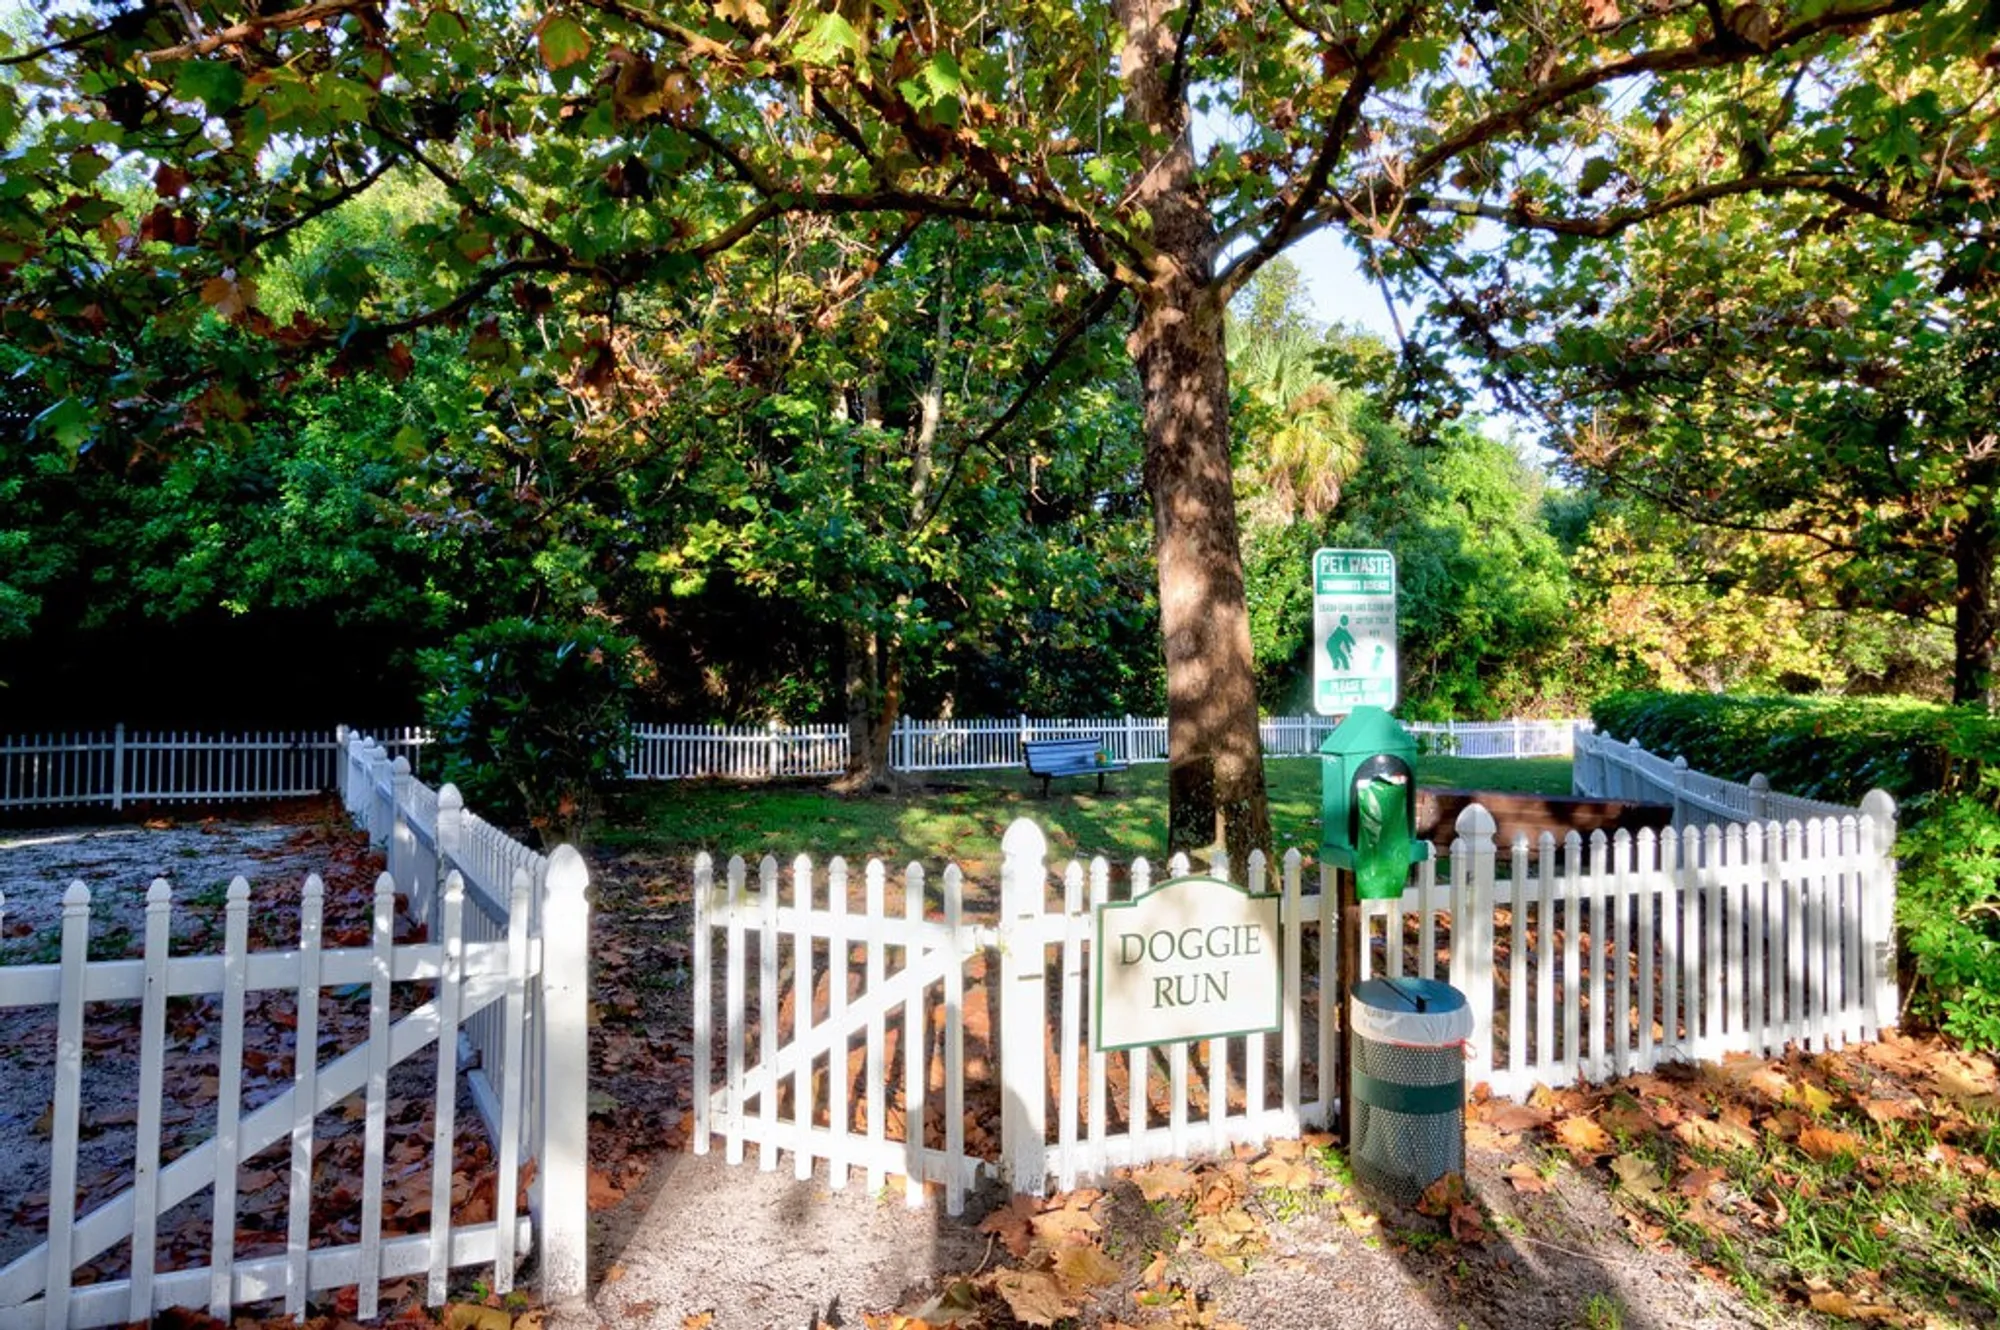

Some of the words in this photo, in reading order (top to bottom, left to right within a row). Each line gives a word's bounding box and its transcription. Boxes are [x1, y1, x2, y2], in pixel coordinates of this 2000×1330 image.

[1320, 555, 1345, 574] PET
[1347, 556, 1390, 575] WASTE
[1119, 924, 1261, 966] DOGGIE
[1153, 971, 1230, 1008] RUN
